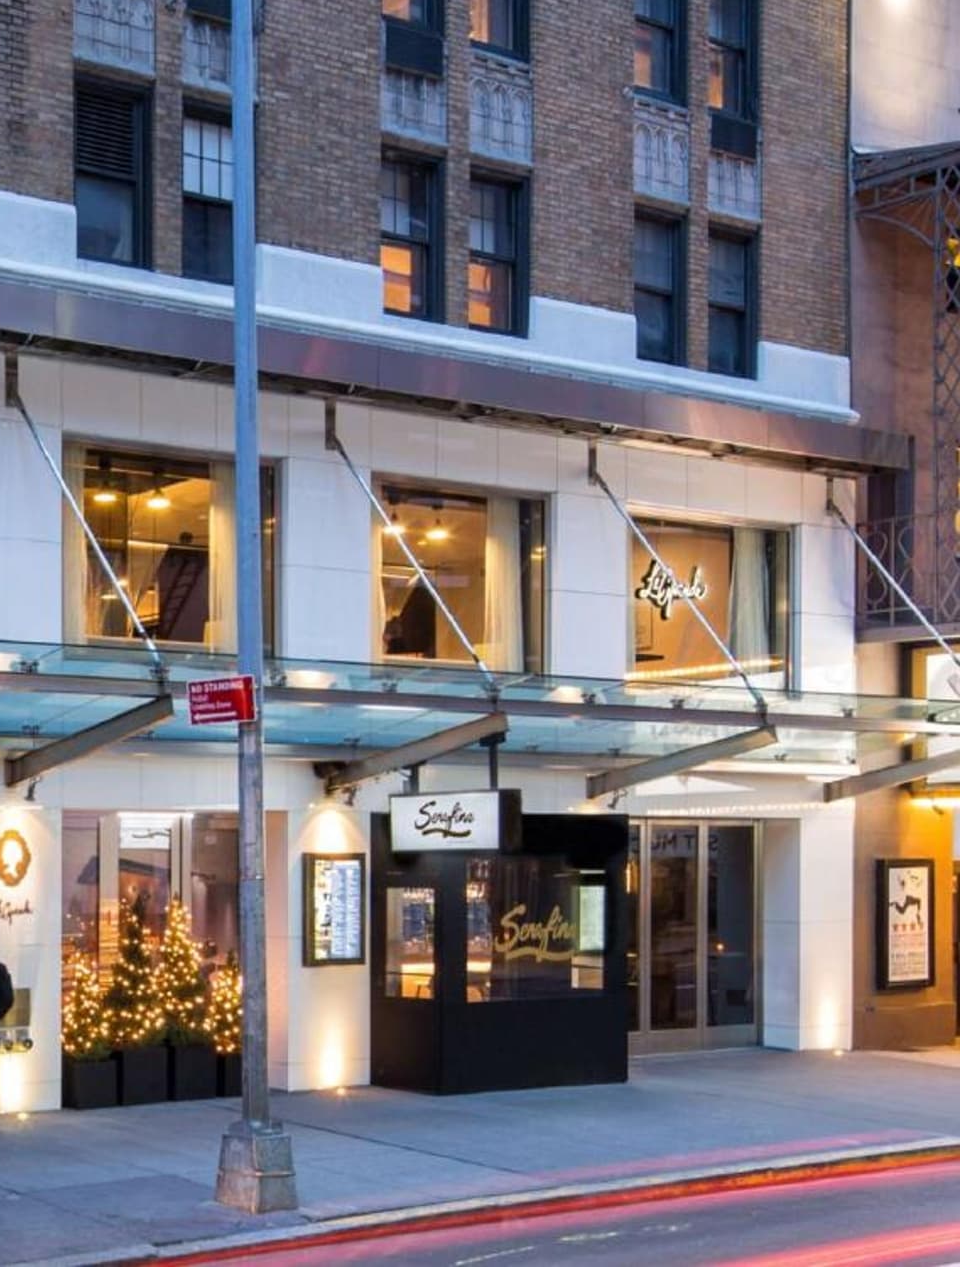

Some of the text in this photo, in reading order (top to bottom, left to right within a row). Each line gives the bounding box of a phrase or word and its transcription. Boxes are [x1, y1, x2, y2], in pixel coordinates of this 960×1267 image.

[191, 680, 244, 694] NO STANDING
[414, 800, 475, 838] Serafina
